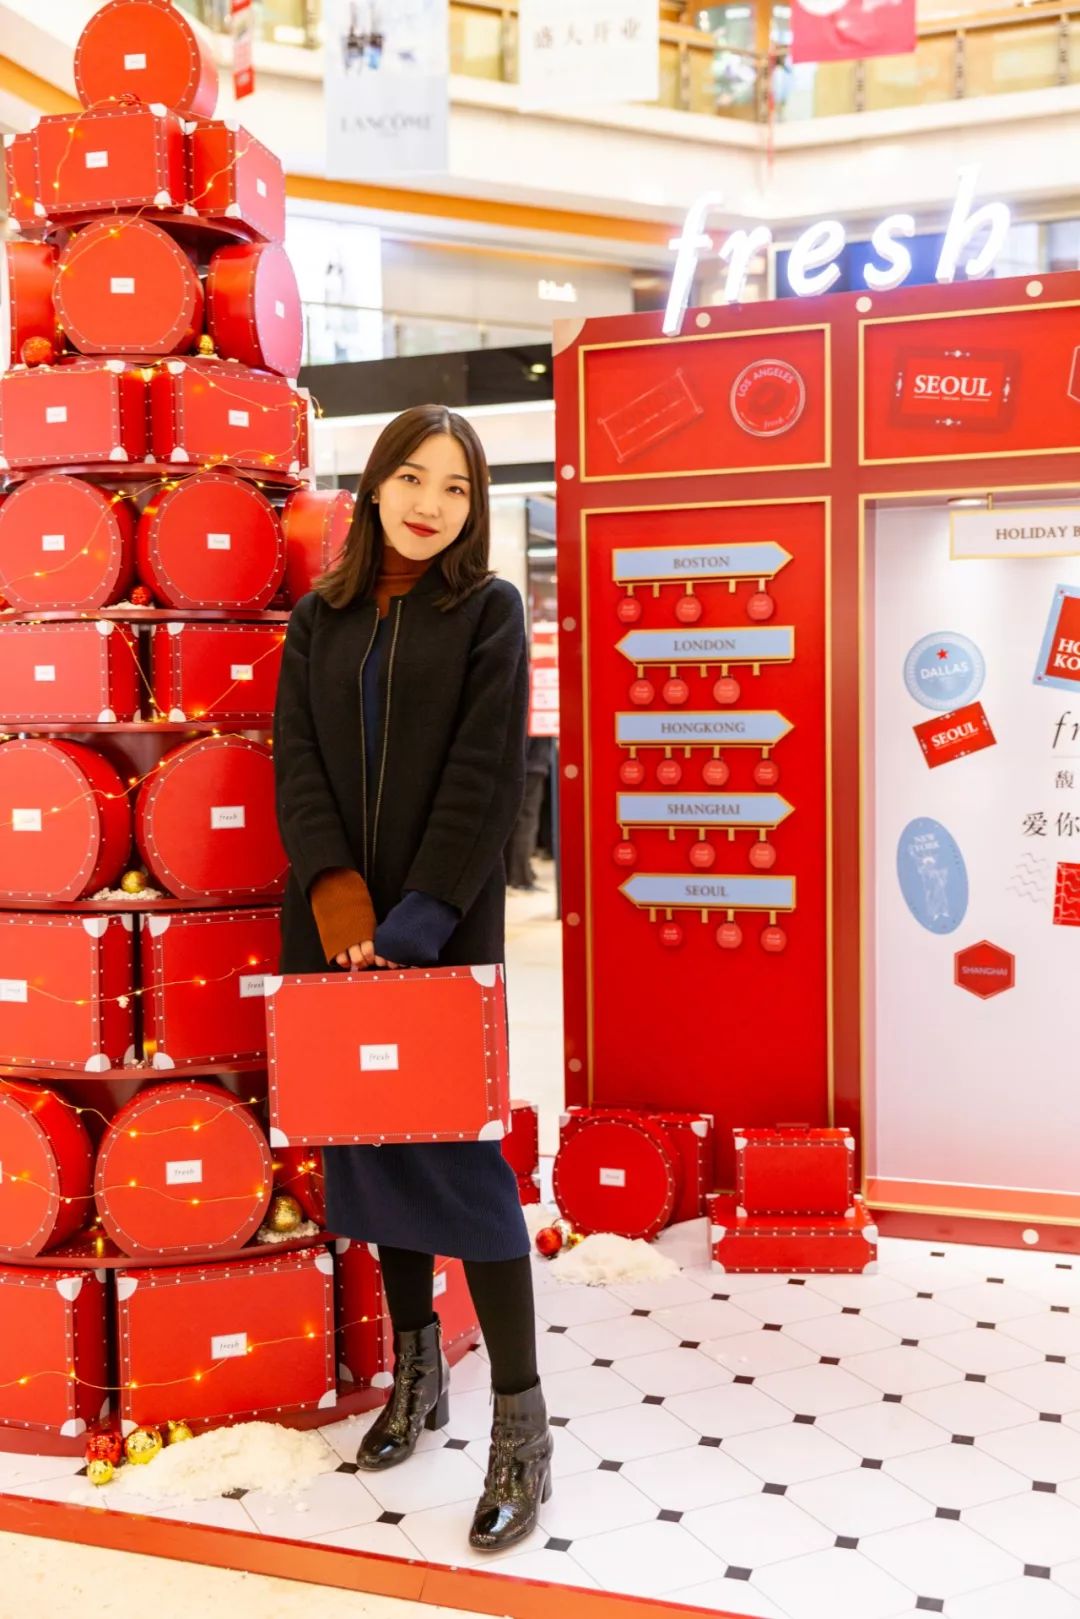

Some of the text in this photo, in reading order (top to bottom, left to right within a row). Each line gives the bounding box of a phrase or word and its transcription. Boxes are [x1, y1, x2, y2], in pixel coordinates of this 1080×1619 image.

[662, 162, 1011, 337] fresh
[736, 366, 794, 397] LOS ANGELES
[914, 375, 992, 397] SEOUL
[996, 525, 1068, 540] HOLIDAY
[673, 556, 730, 570] BOSTON
[674, 639, 736, 652] LONDON
[920, 661, 969, 680] DALLAS
[661, 721, 746, 734] HONGKONG
[931, 722, 979, 747] SEOUL
[667, 803, 740, 816] SHANGHAI
[1022, 811, 1080, 837] 爱你
[685, 884, 728, 897] SEOUL
[961, 965, 1009, 977] SHANGHAI
